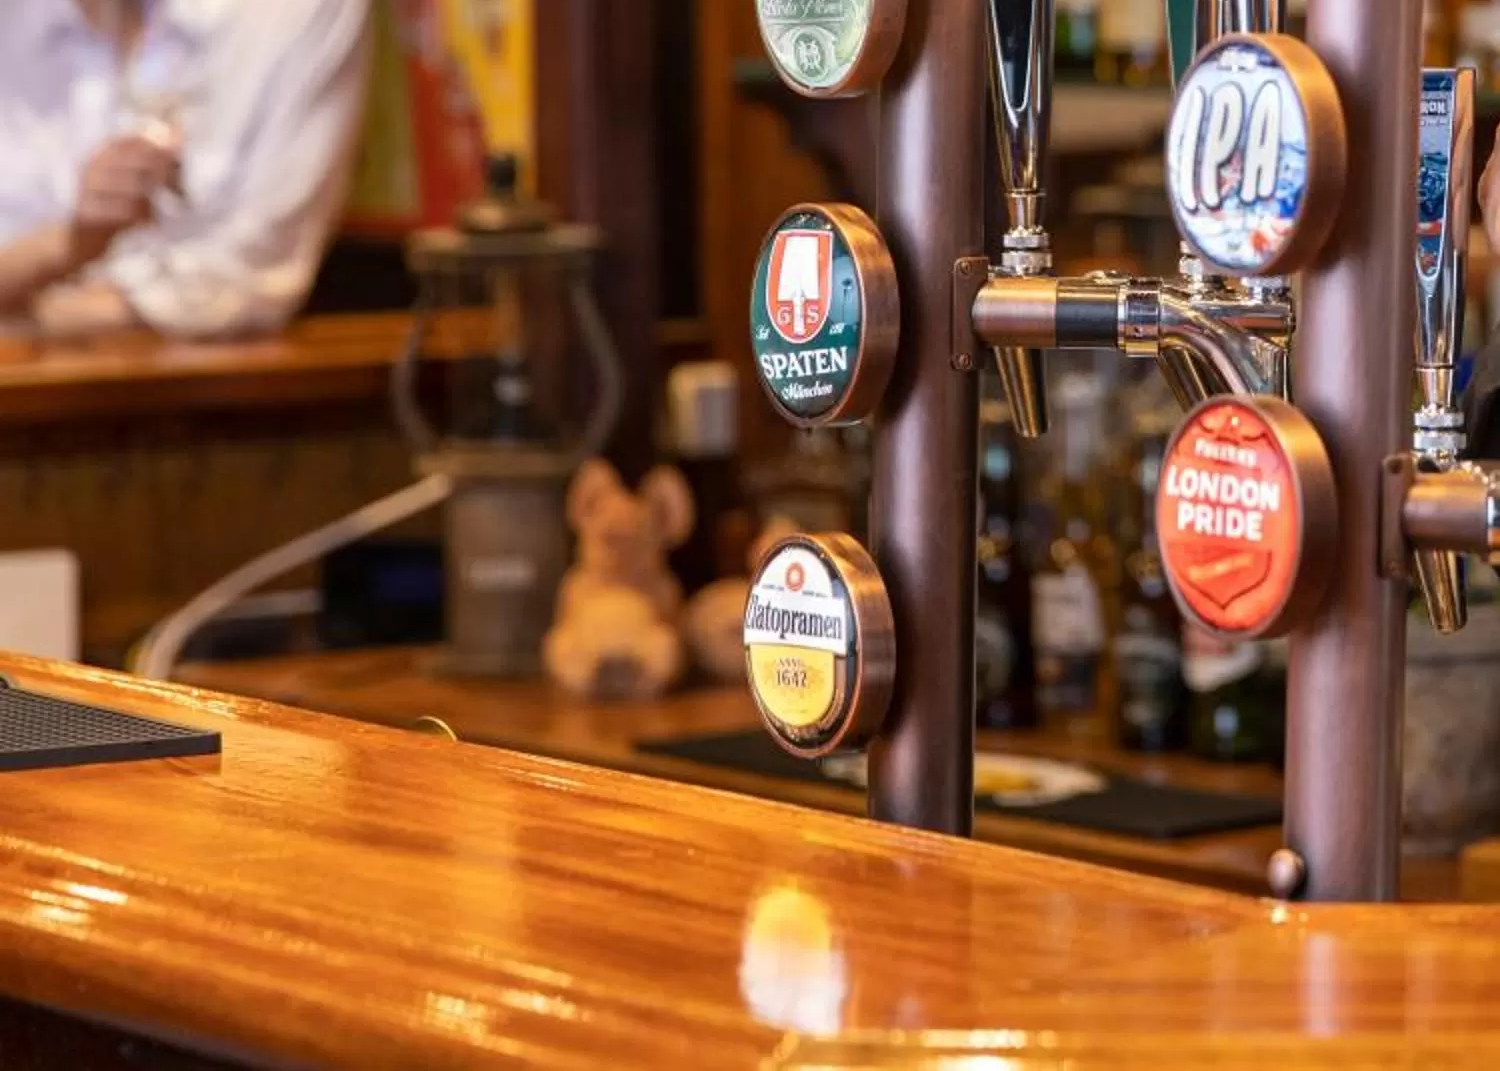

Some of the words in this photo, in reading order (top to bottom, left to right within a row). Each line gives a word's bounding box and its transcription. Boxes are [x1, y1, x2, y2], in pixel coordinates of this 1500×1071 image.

[1179, 80, 1283, 214] IPA
[759, 346, 849, 379] SPATEN
[1166, 464, 1280, 511] LONDON
[1176, 501, 1263, 542] PRIDE
[776, 670, 807, 688] 1642
